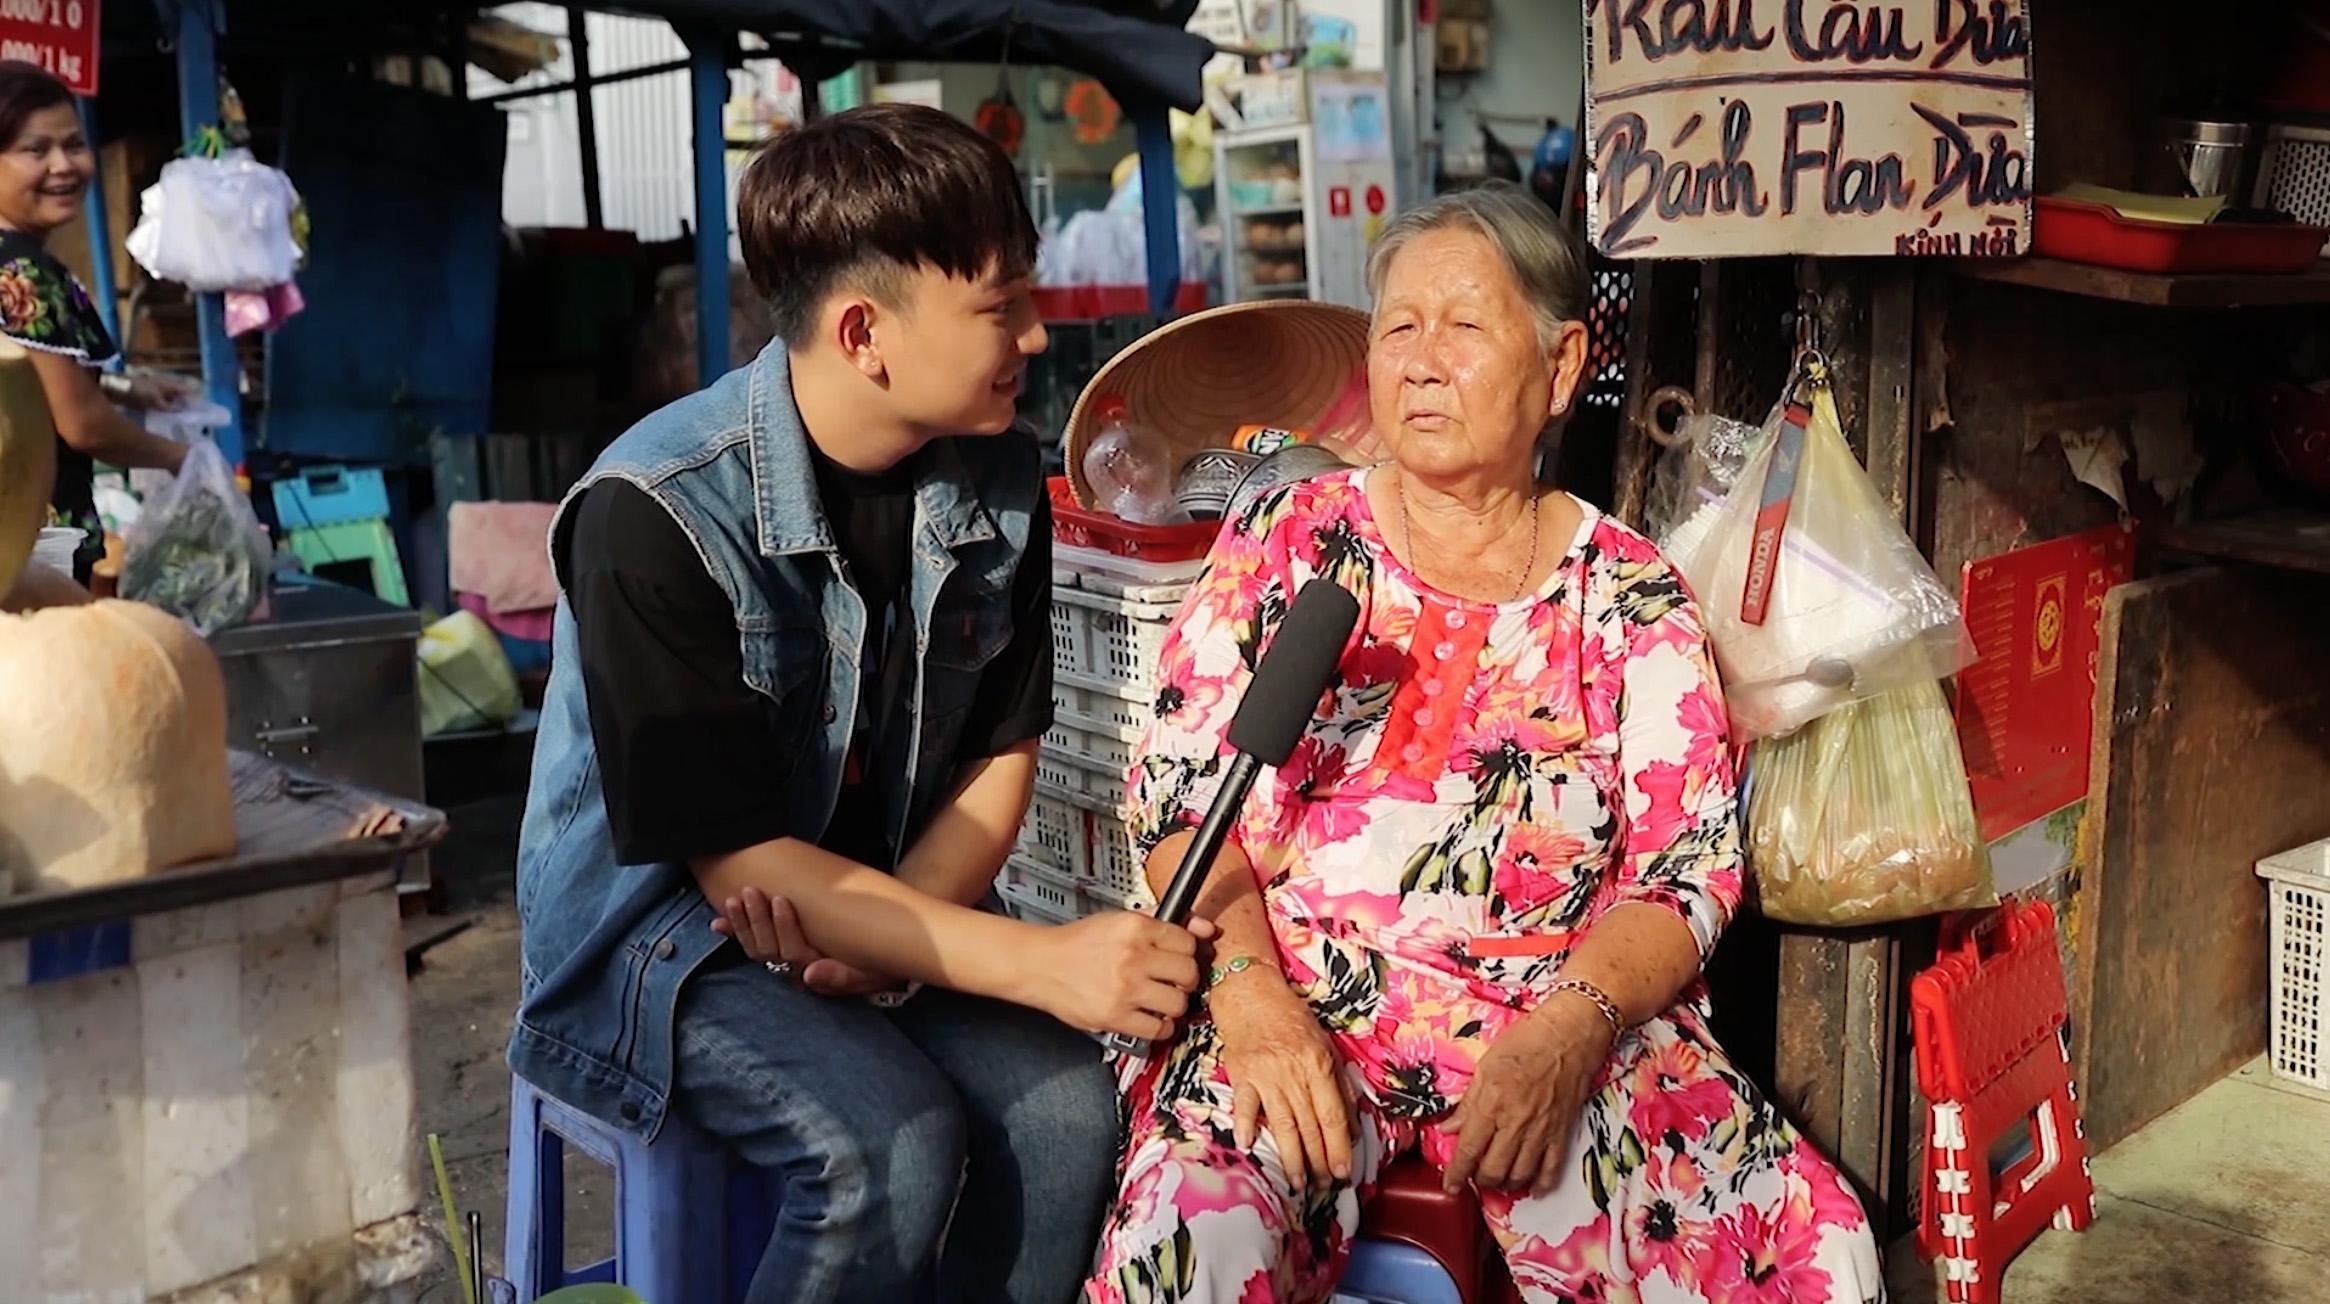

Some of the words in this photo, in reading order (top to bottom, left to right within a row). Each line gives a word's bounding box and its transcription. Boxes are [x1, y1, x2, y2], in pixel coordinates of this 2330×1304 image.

[0, 39, 54, 74] 000/1
[1590, 0, 1775, 64] Rau
[1597, 98, 1768, 256] Bánh
[1780, 100, 1915, 217] Flan
[1746, 527, 1775, 607] HONDA
